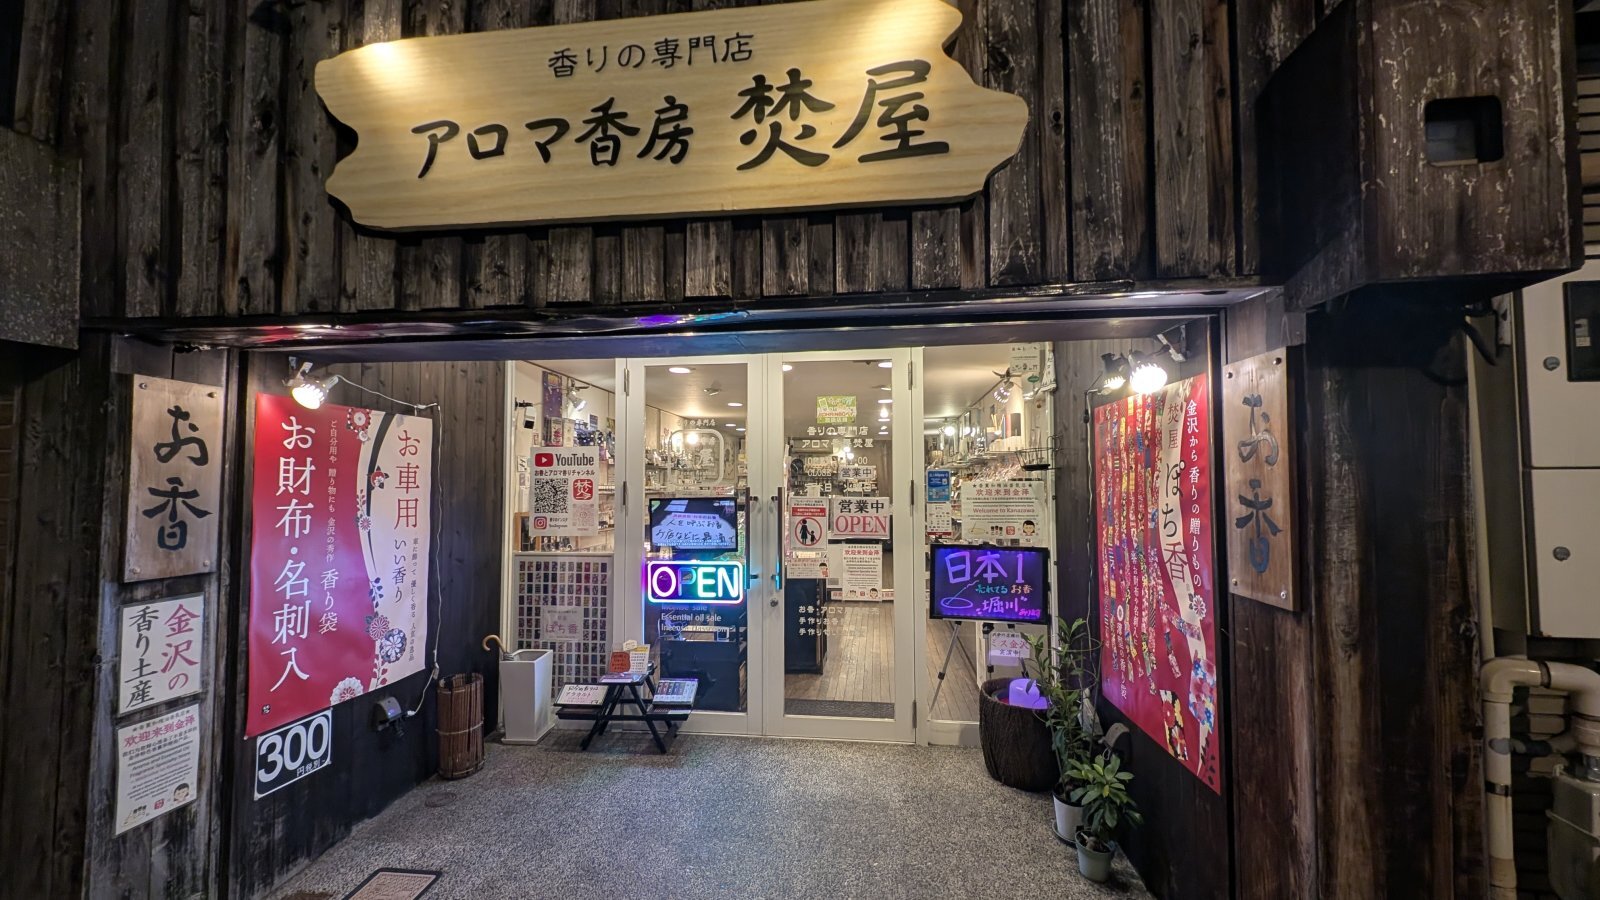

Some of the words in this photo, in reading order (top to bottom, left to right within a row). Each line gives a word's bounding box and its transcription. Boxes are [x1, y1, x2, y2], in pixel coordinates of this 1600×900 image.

[548, 33, 755, 78] 香りの専門店
[410, 96, 695, 179] アロマ香房
[730, 59, 950, 171] 焚屋
[806, 426, 869, 436] 香りの専門店
[1167, 402, 1180, 450] 焚屋
[142, 405, 213, 551] お香
[394, 429, 421, 531] お車用
[555, 453, 594, 467] YouTube
[842, 467, 872, 477] 営業中
[1186, 399, 1202, 587] 金沢から香りの贈りもの
[1235, 393, 1283, 574] お香
[835, 515, 888, 533] OPEN
[838, 499, 884, 513] 営業中
[1162, 459, 1189, 584] ぽち香
[270, 416, 317, 692] お財布・名刺入
[392, 539, 407, 603] いい香り
[652, 566, 738, 598] OPEN
[318, 568, 339, 635] 香り袋
[661, 613, 693, 621] Essential
[706, 613, 722, 622] sale
[124, 606, 160, 710] 香り土産
[160, 603, 200, 691] 金沢の
[258, 716, 329, 783] 300
